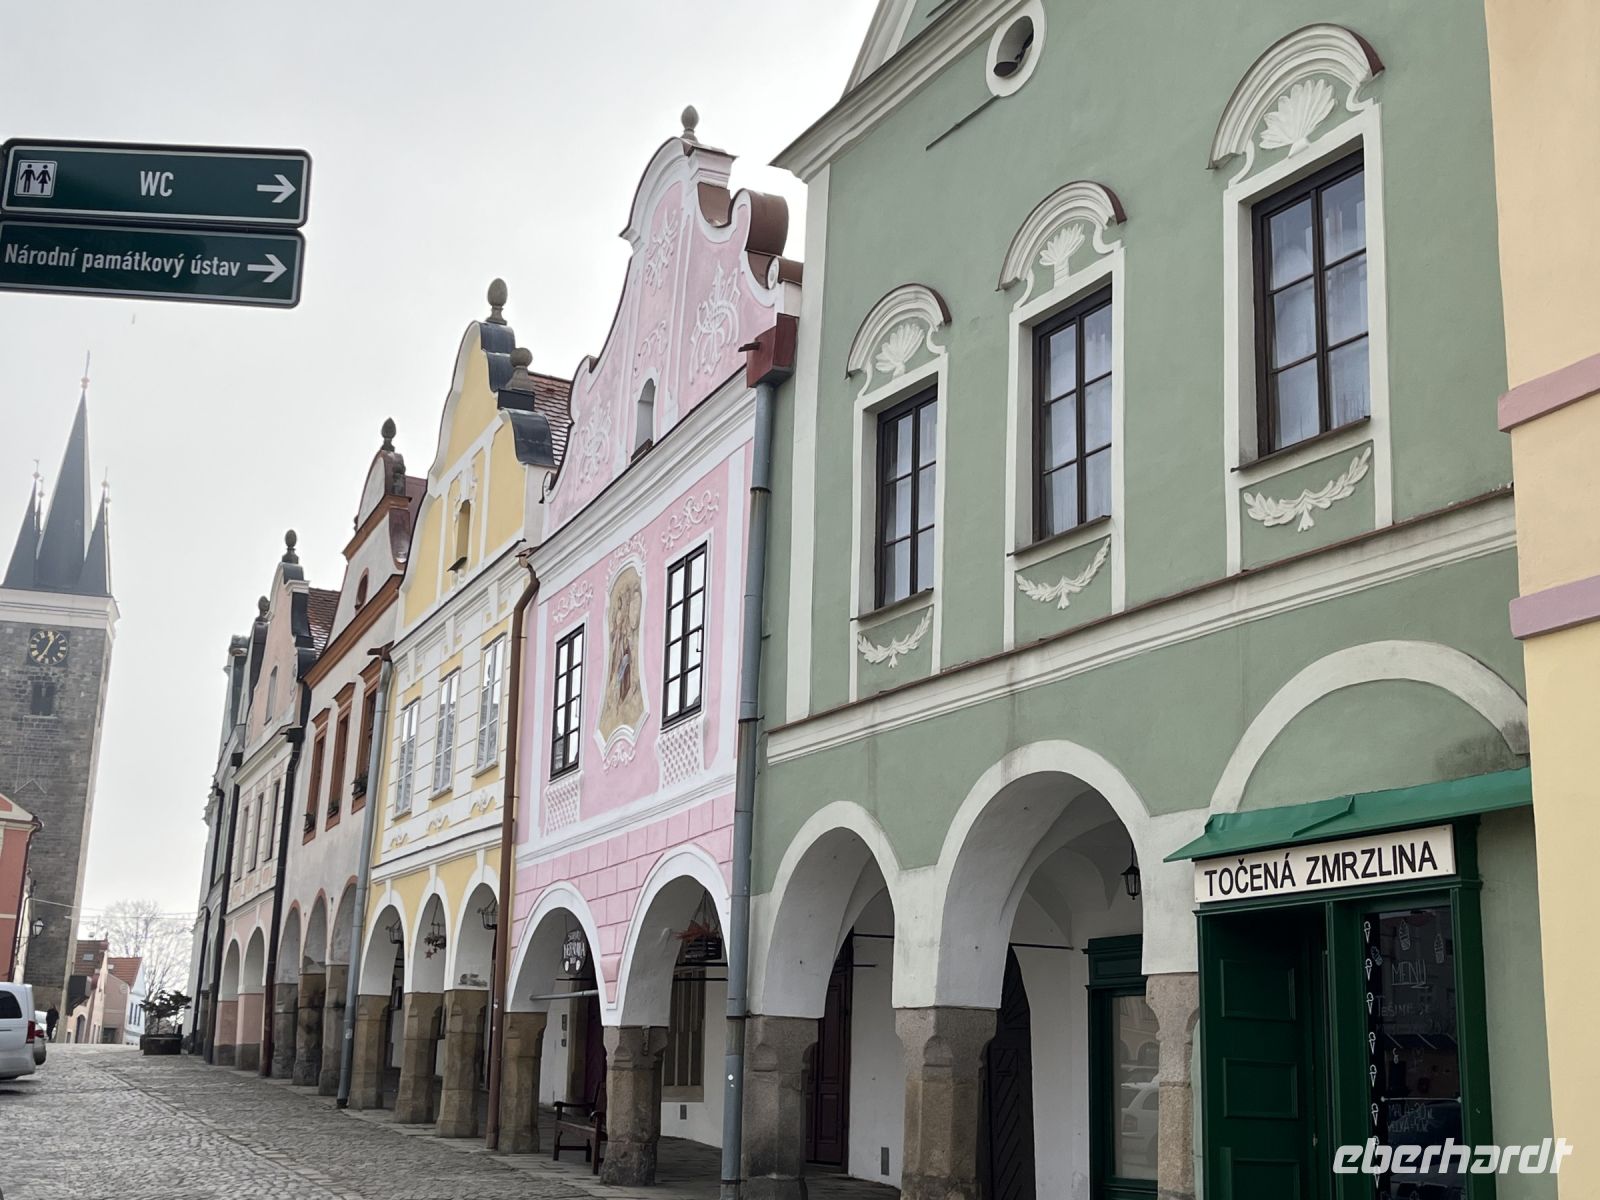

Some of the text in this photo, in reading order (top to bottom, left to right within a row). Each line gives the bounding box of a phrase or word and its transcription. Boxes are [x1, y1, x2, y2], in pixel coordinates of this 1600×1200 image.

[140, 170, 174, 197] WC
[5, 243, 240, 278] Národní památkový ústav
[1204, 840, 1438, 897] TOČENÁ ZMRZLINA
[1391, 959, 1427, 984] MENU
